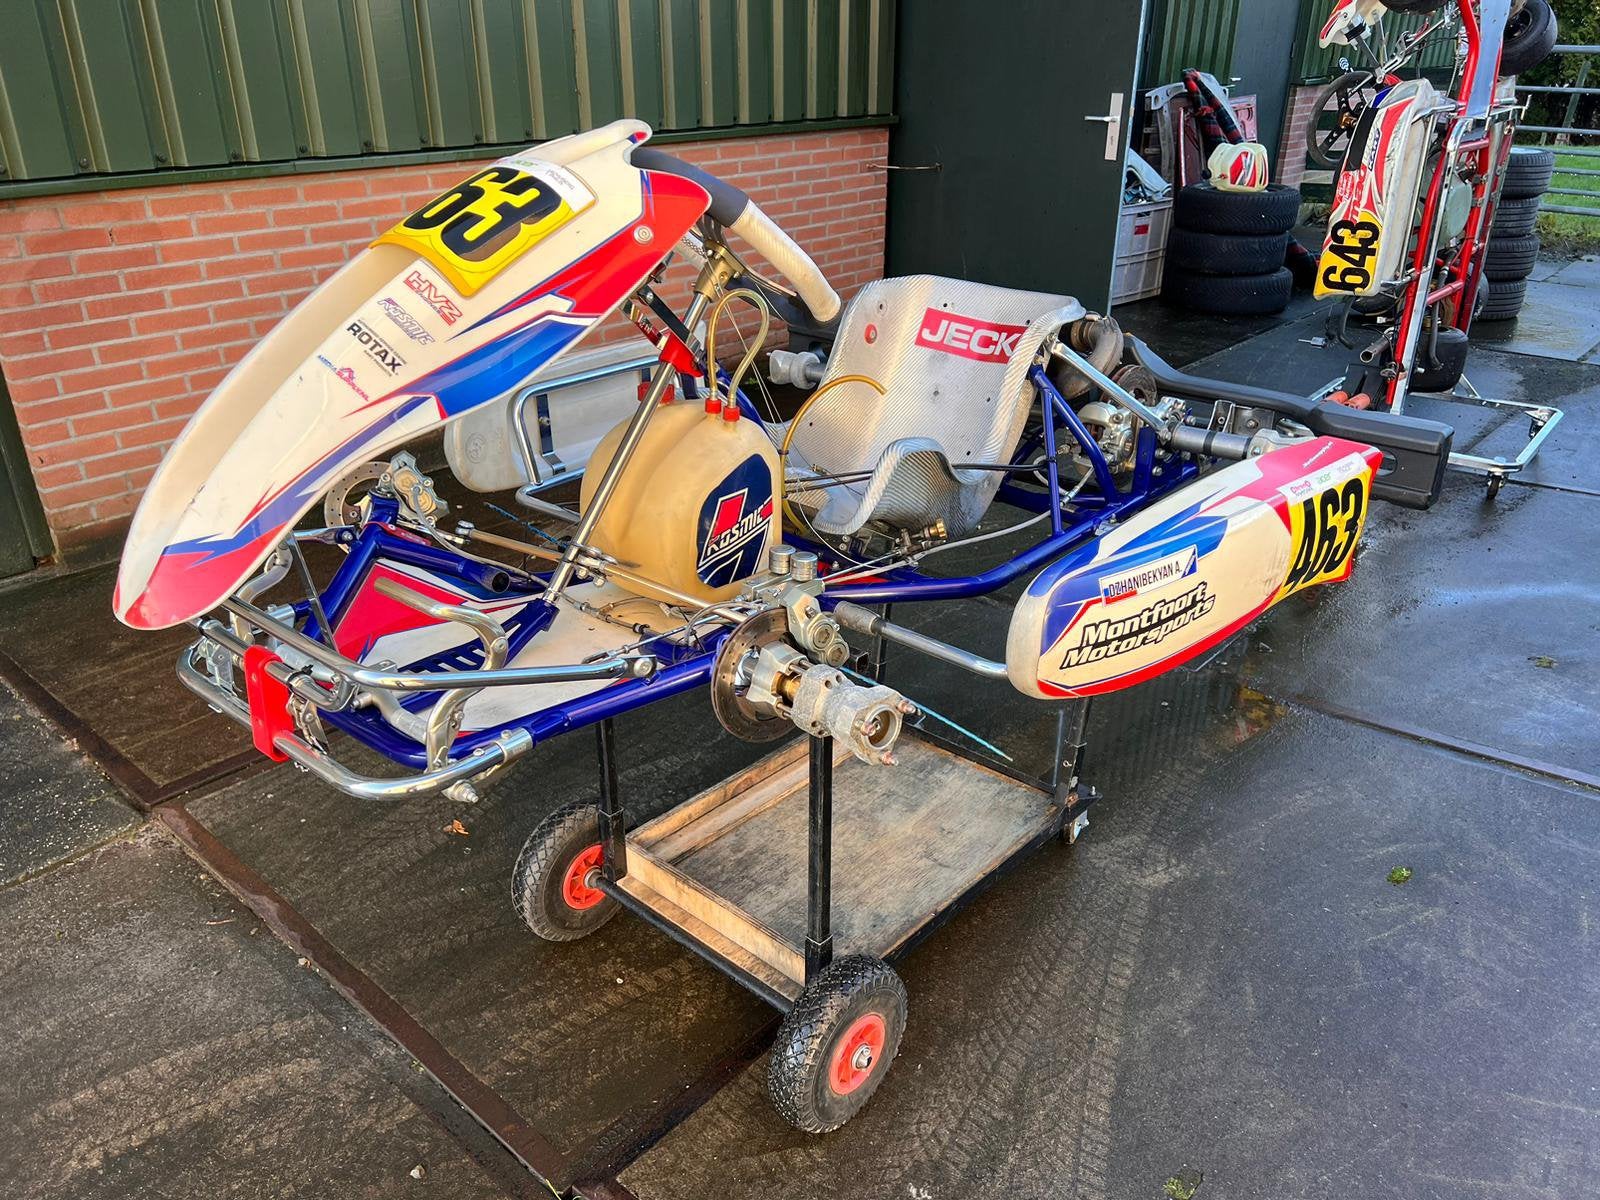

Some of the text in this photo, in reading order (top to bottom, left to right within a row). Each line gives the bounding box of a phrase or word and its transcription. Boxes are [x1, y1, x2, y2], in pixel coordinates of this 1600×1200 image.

[1322, 218, 1380, 294] 643
[403, 270, 463, 326] HVZ
[346, 322, 402, 373] ROTAX
[1284, 477, 1363, 595] 463
[1108, 560, 1183, 597] DZHANIBEKYAN A.
[1059, 594, 1216, 669] Motorsports
[1080, 581, 1207, 646] Montfoort
